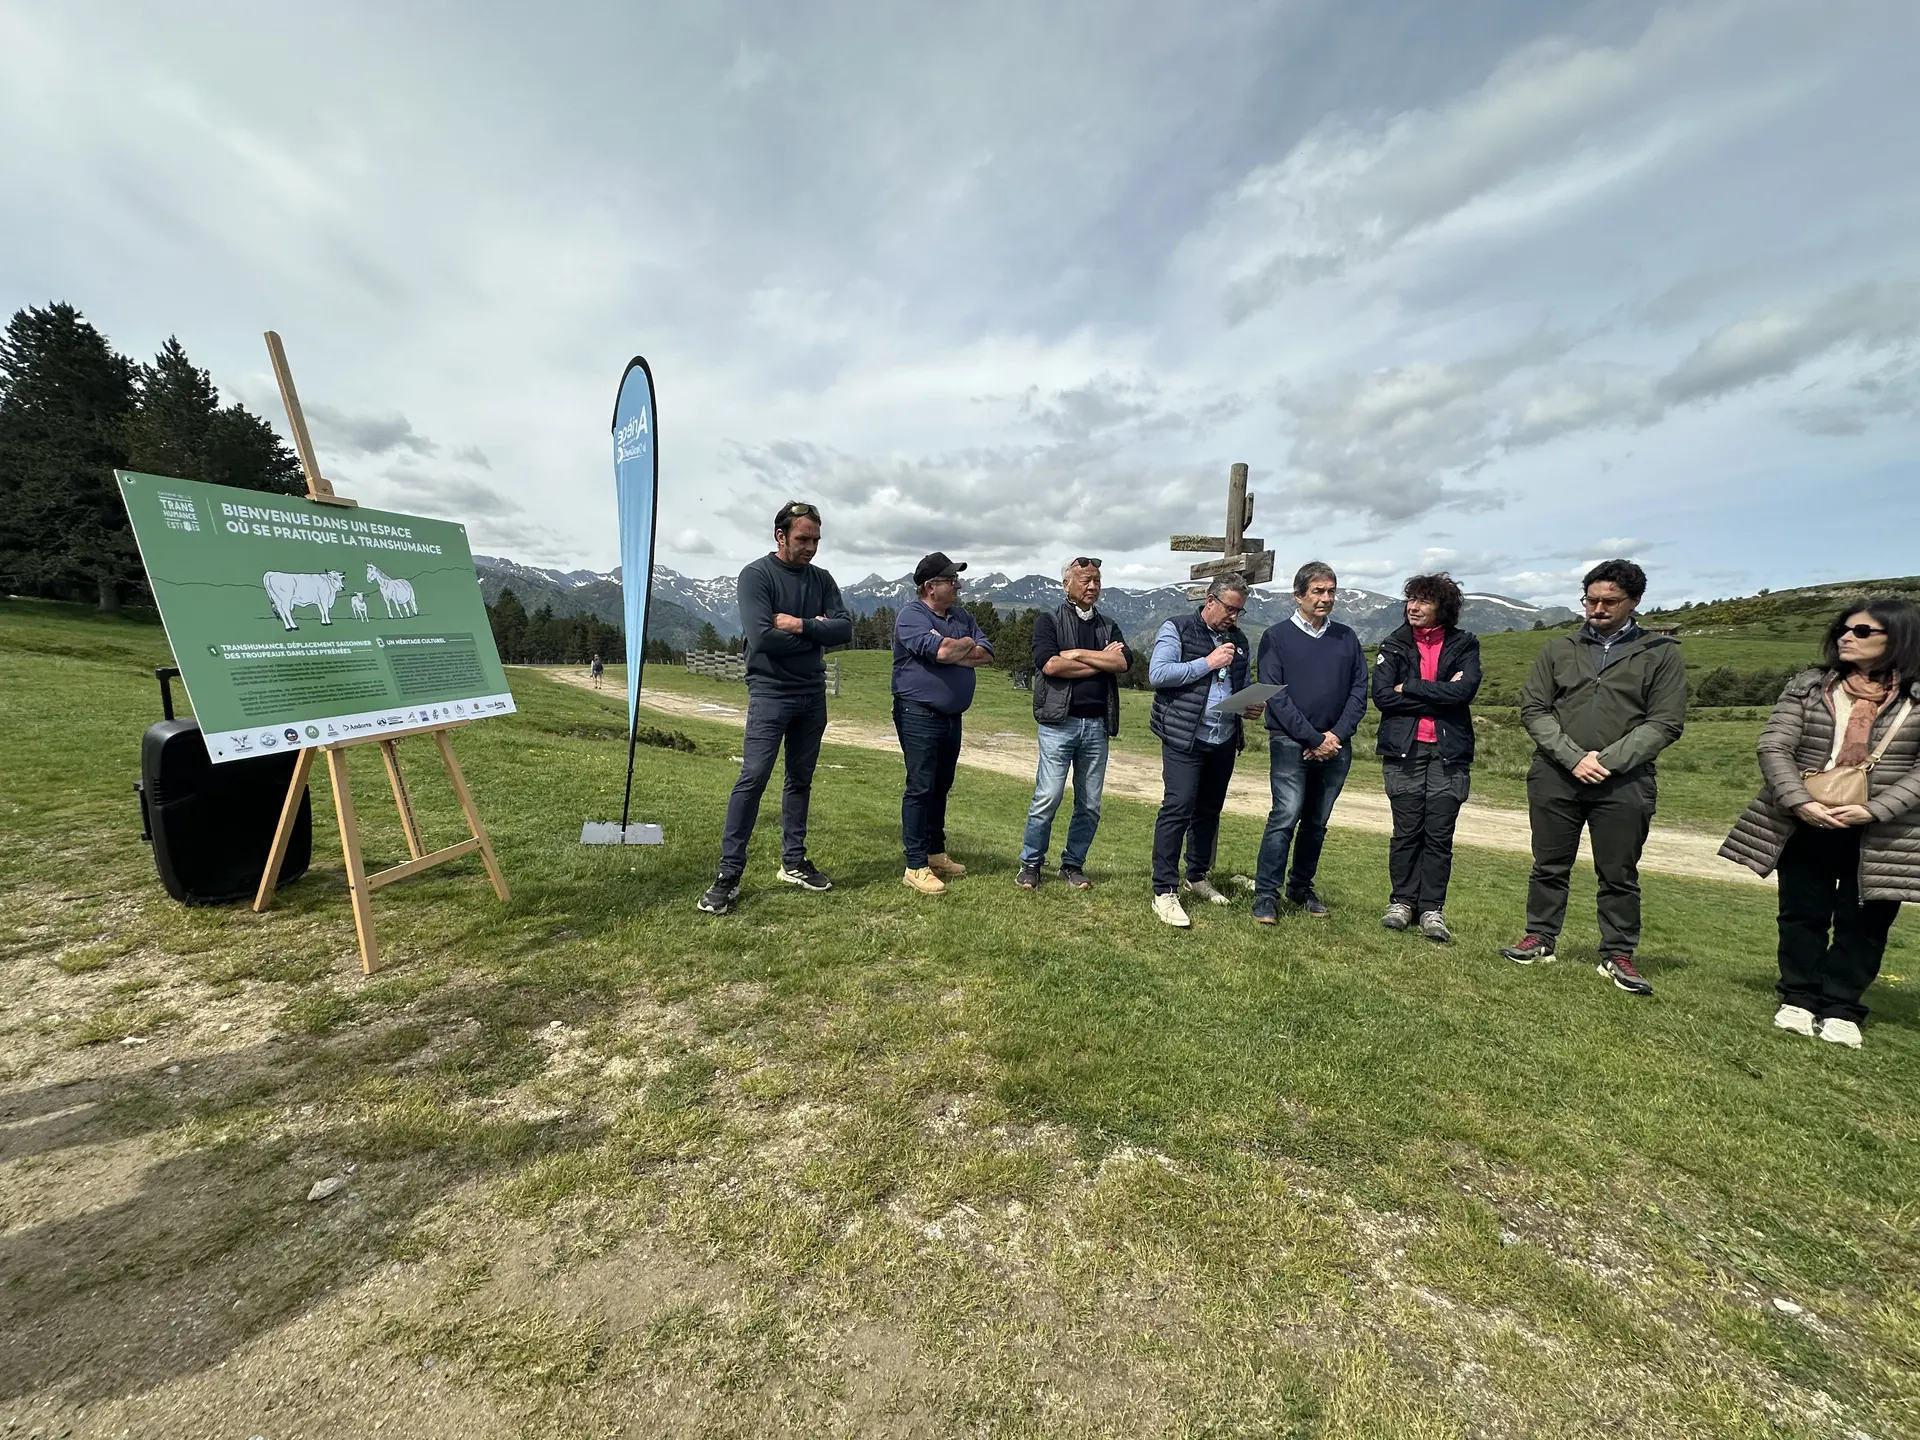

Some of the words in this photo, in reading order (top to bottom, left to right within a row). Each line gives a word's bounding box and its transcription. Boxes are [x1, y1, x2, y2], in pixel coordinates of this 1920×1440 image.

[159, 499, 195, 512] TRANS
[163, 510, 198, 520] HUMANCE
[221, 502, 311, 525] BIENVENUE
[312, 514, 349, 531] DANS
[350, 520, 369, 533] UN
[370, 523, 413, 539] ESPACE
[226, 518, 249, 534] OÙ
[252, 523, 272, 537] SE
[273, 526, 339, 544] PRATIQUE
[341, 533, 358, 546] LA
[358, 536, 443, 555] TRANSHUMANCE
[220, 643, 287, 652] TRANSHUMANCE,
[286, 640, 336, 649] DÉPLACEMENT
[335, 640, 373, 648] SAISONNIER
[224, 652, 241, 660] DES
[241, 651, 286, 659] TROUPEAUX
[286, 649, 306, 657] DANS
[306, 648, 319, 656] LES
[319, 646, 353, 656] PYRÉNÉES
[350, 722, 373, 731] Andorra
